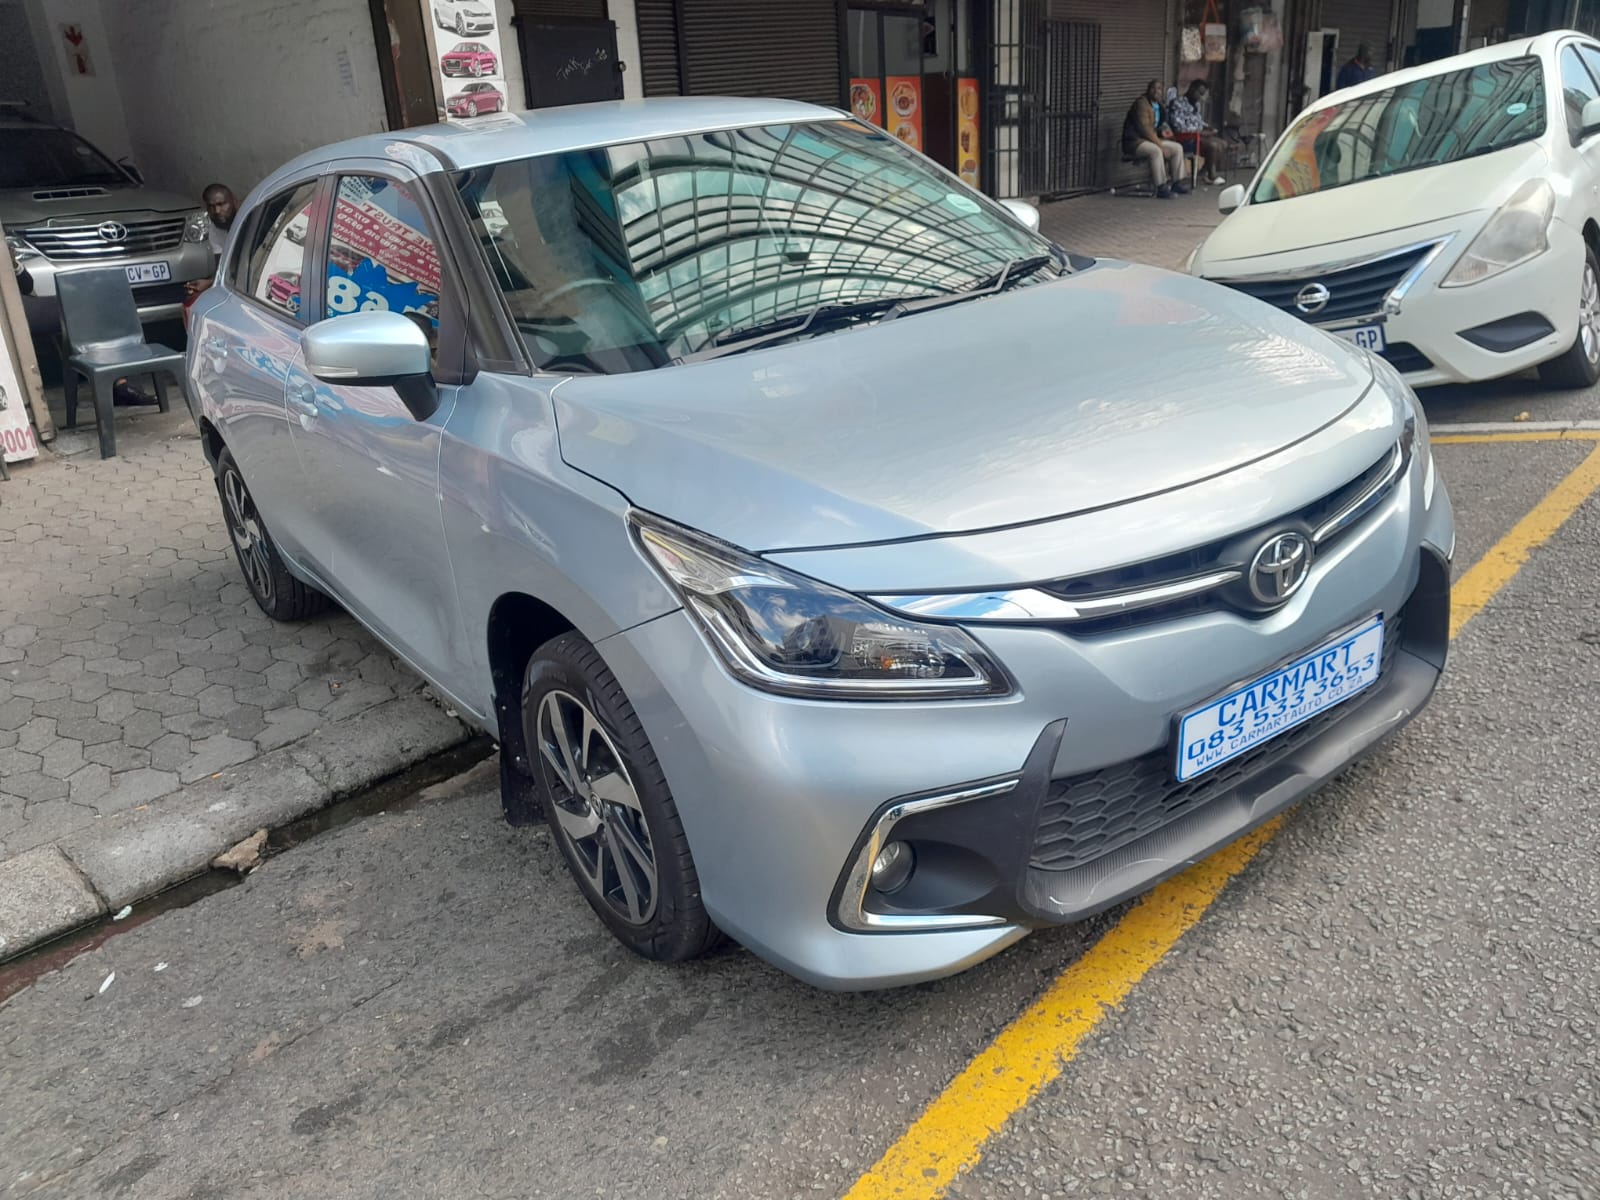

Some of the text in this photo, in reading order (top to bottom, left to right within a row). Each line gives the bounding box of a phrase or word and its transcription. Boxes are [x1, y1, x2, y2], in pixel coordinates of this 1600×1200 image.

[127, 264, 166, 281] CV GP
[1355, 329, 1377, 349] GP
[1187, 652, 1375, 760] 083 533 3653
[1218, 641, 1356, 727] CARMART
